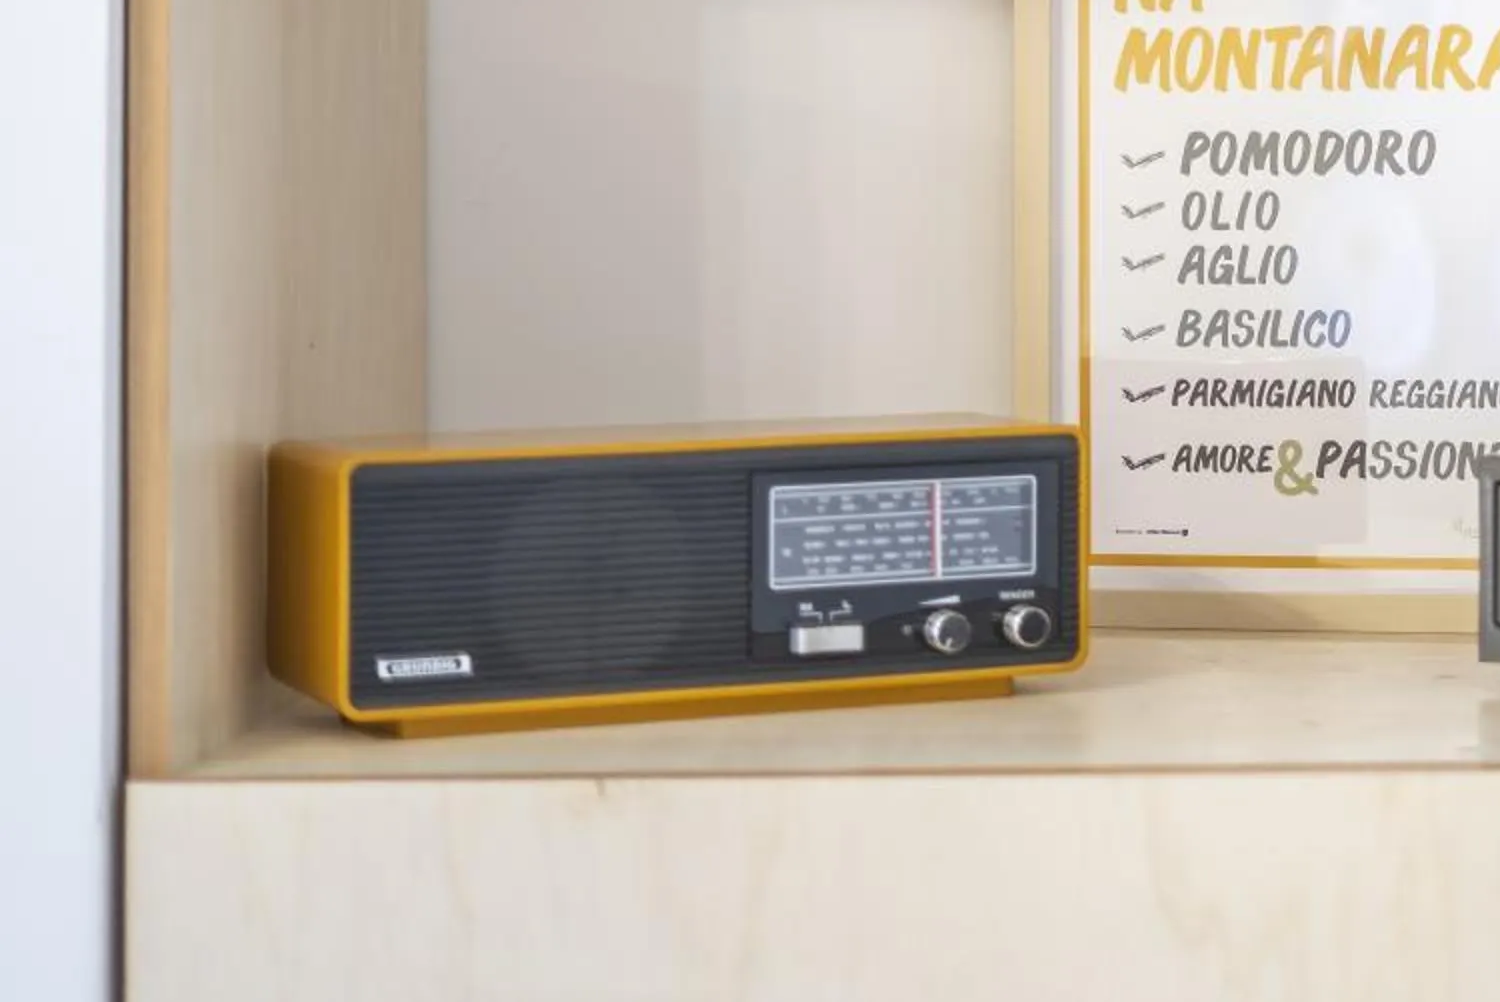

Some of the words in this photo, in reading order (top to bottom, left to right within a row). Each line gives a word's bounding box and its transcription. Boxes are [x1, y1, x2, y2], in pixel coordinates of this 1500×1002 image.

[1180, 129, 1437, 176] POMODORO
[1181, 190, 1280, 231] OLIO
[1177, 245, 1298, 285] AGLIO
[1176, 309, 1352, 348] BASILICO
[1171, 378, 1356, 409] PARMIGIANO
[1171, 444, 1274, 473] AMORE
[1274, 439, 1319, 496] &
